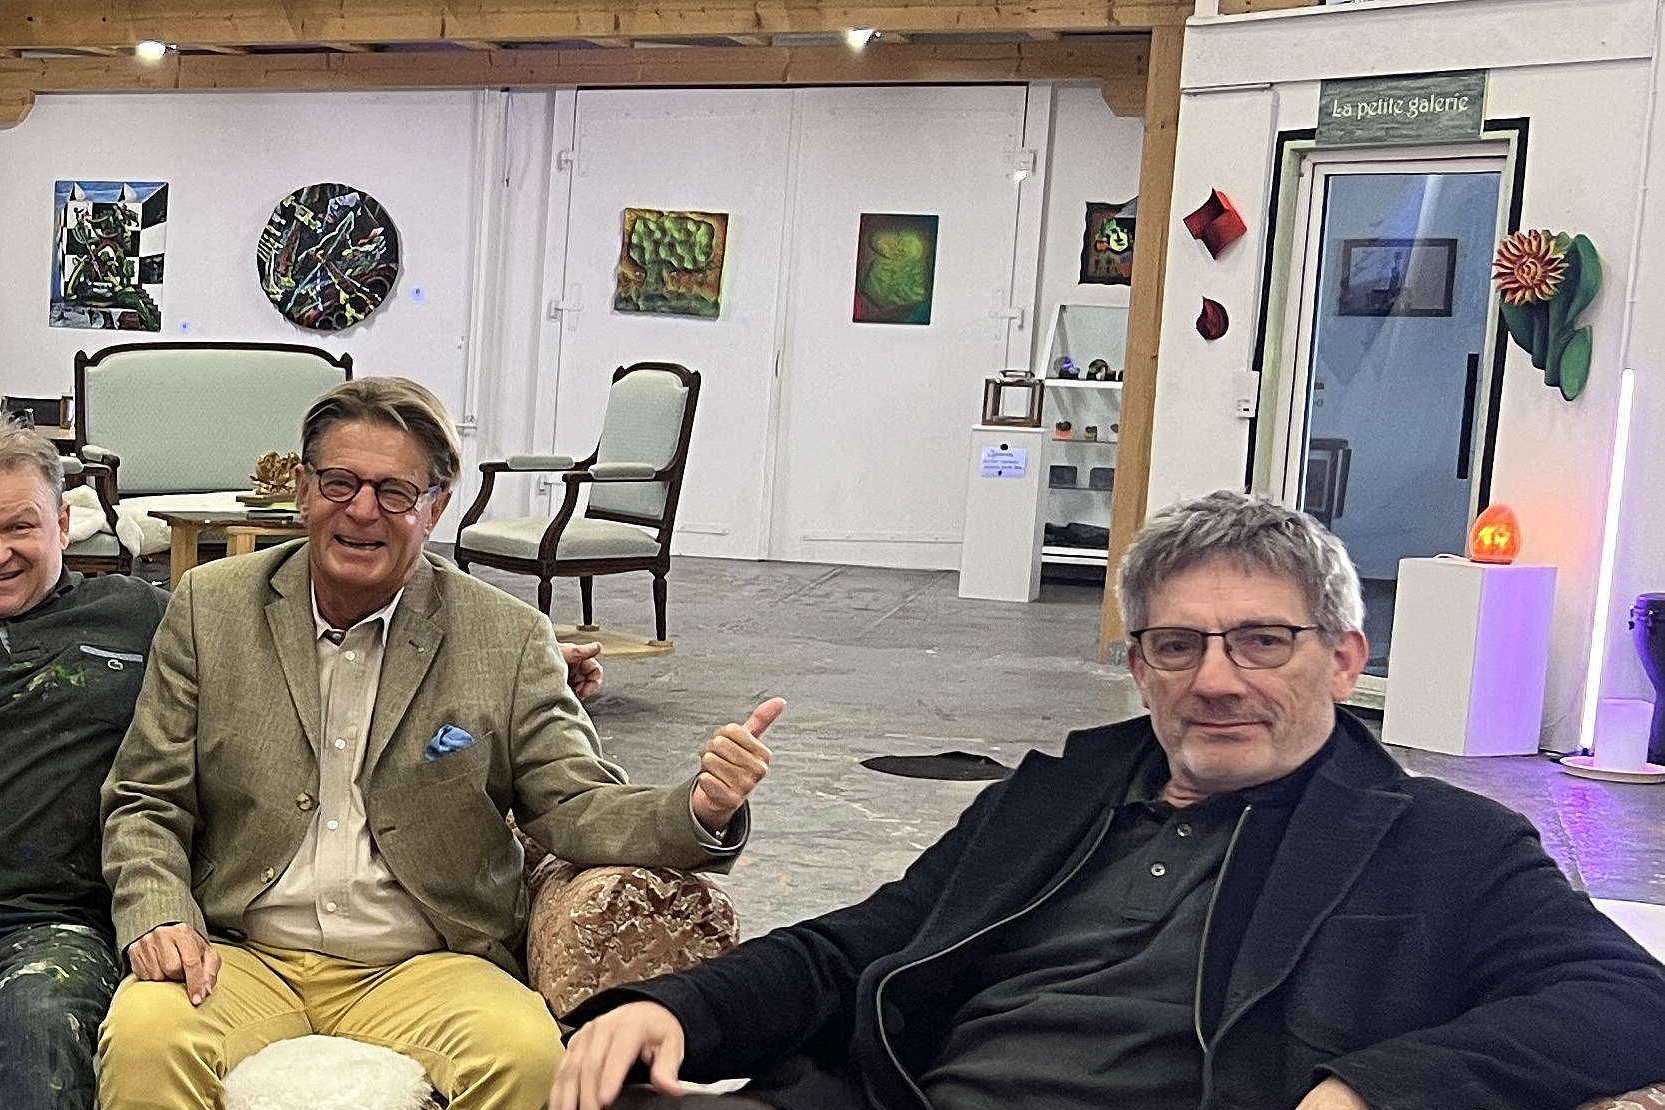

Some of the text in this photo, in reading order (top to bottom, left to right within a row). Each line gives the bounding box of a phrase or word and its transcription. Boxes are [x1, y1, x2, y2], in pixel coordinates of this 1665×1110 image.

[1331, 93, 1469, 120] La petite galerie
